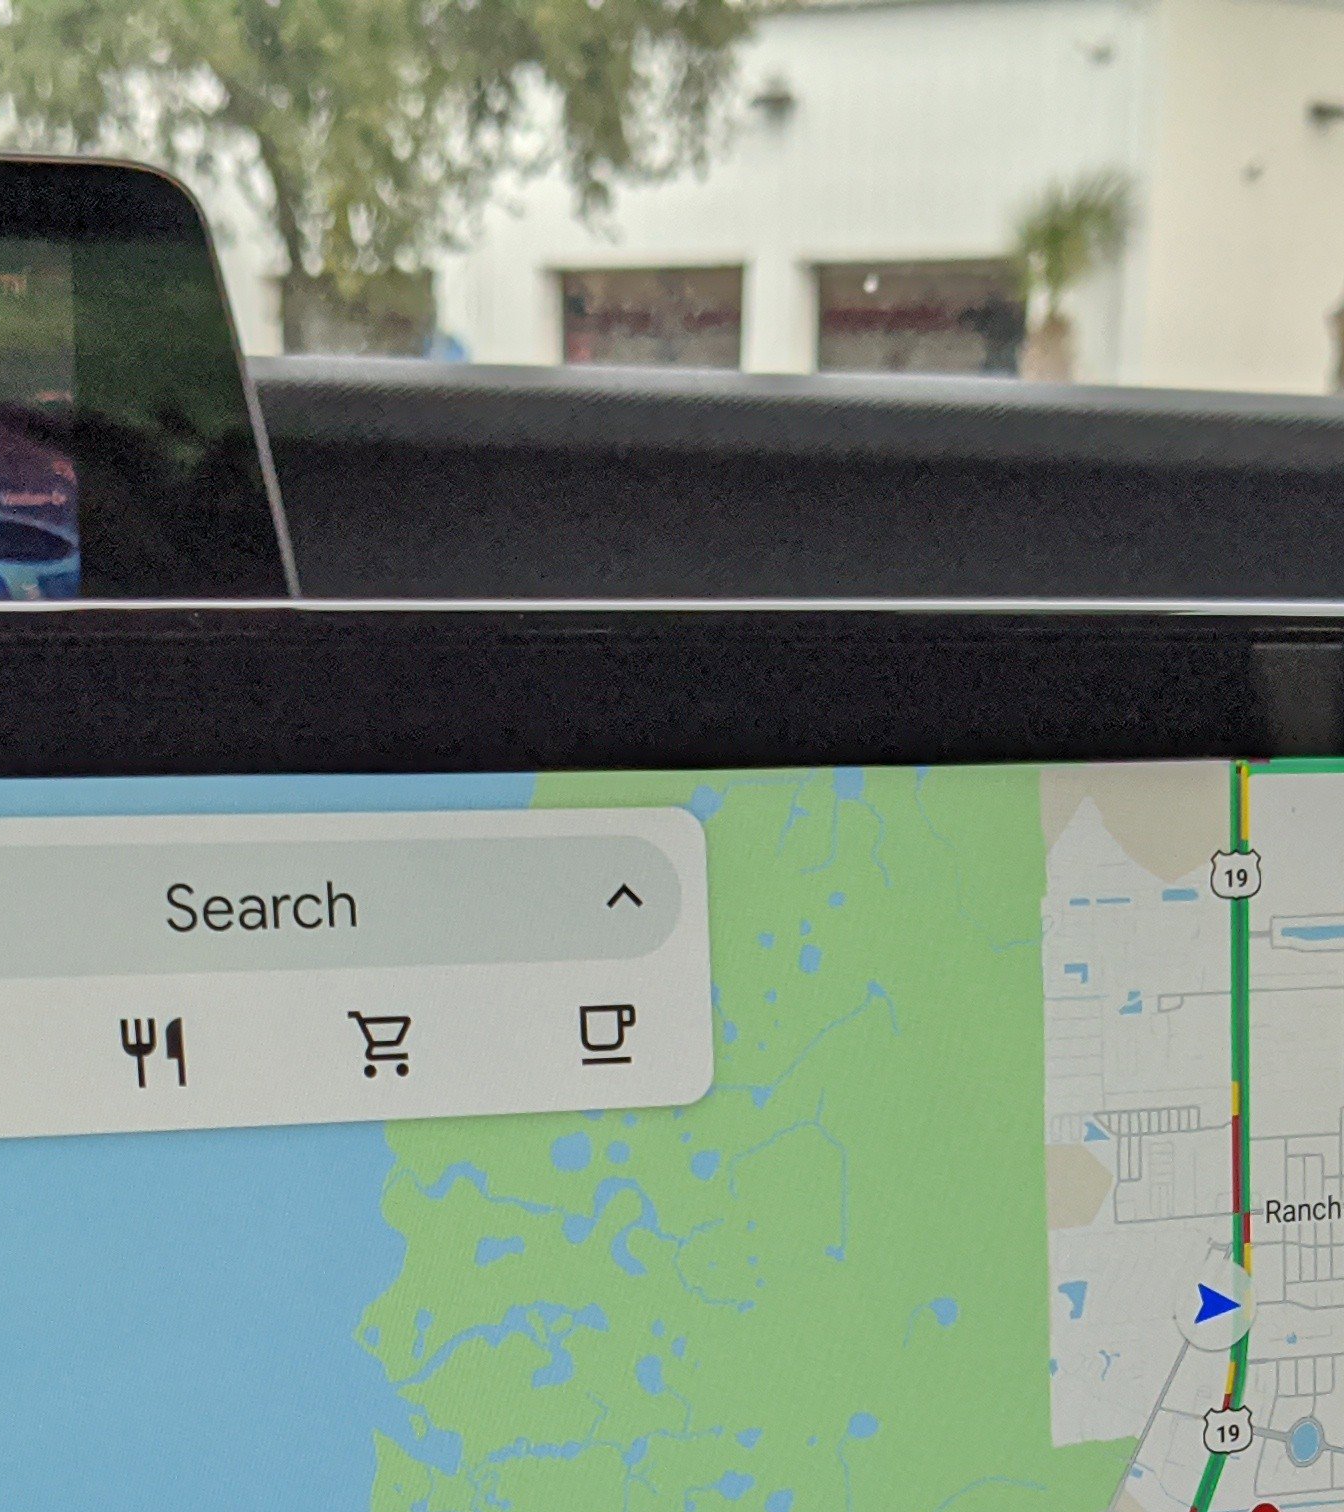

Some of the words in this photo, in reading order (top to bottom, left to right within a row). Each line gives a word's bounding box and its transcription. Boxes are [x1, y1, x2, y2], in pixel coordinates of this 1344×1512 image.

[1224, 868, 1249, 888] 19
[165, 880, 358, 934] Search
[1264, 1195, 1342, 1225] Ranch
[1216, 1424, 1240, 1444] 19
